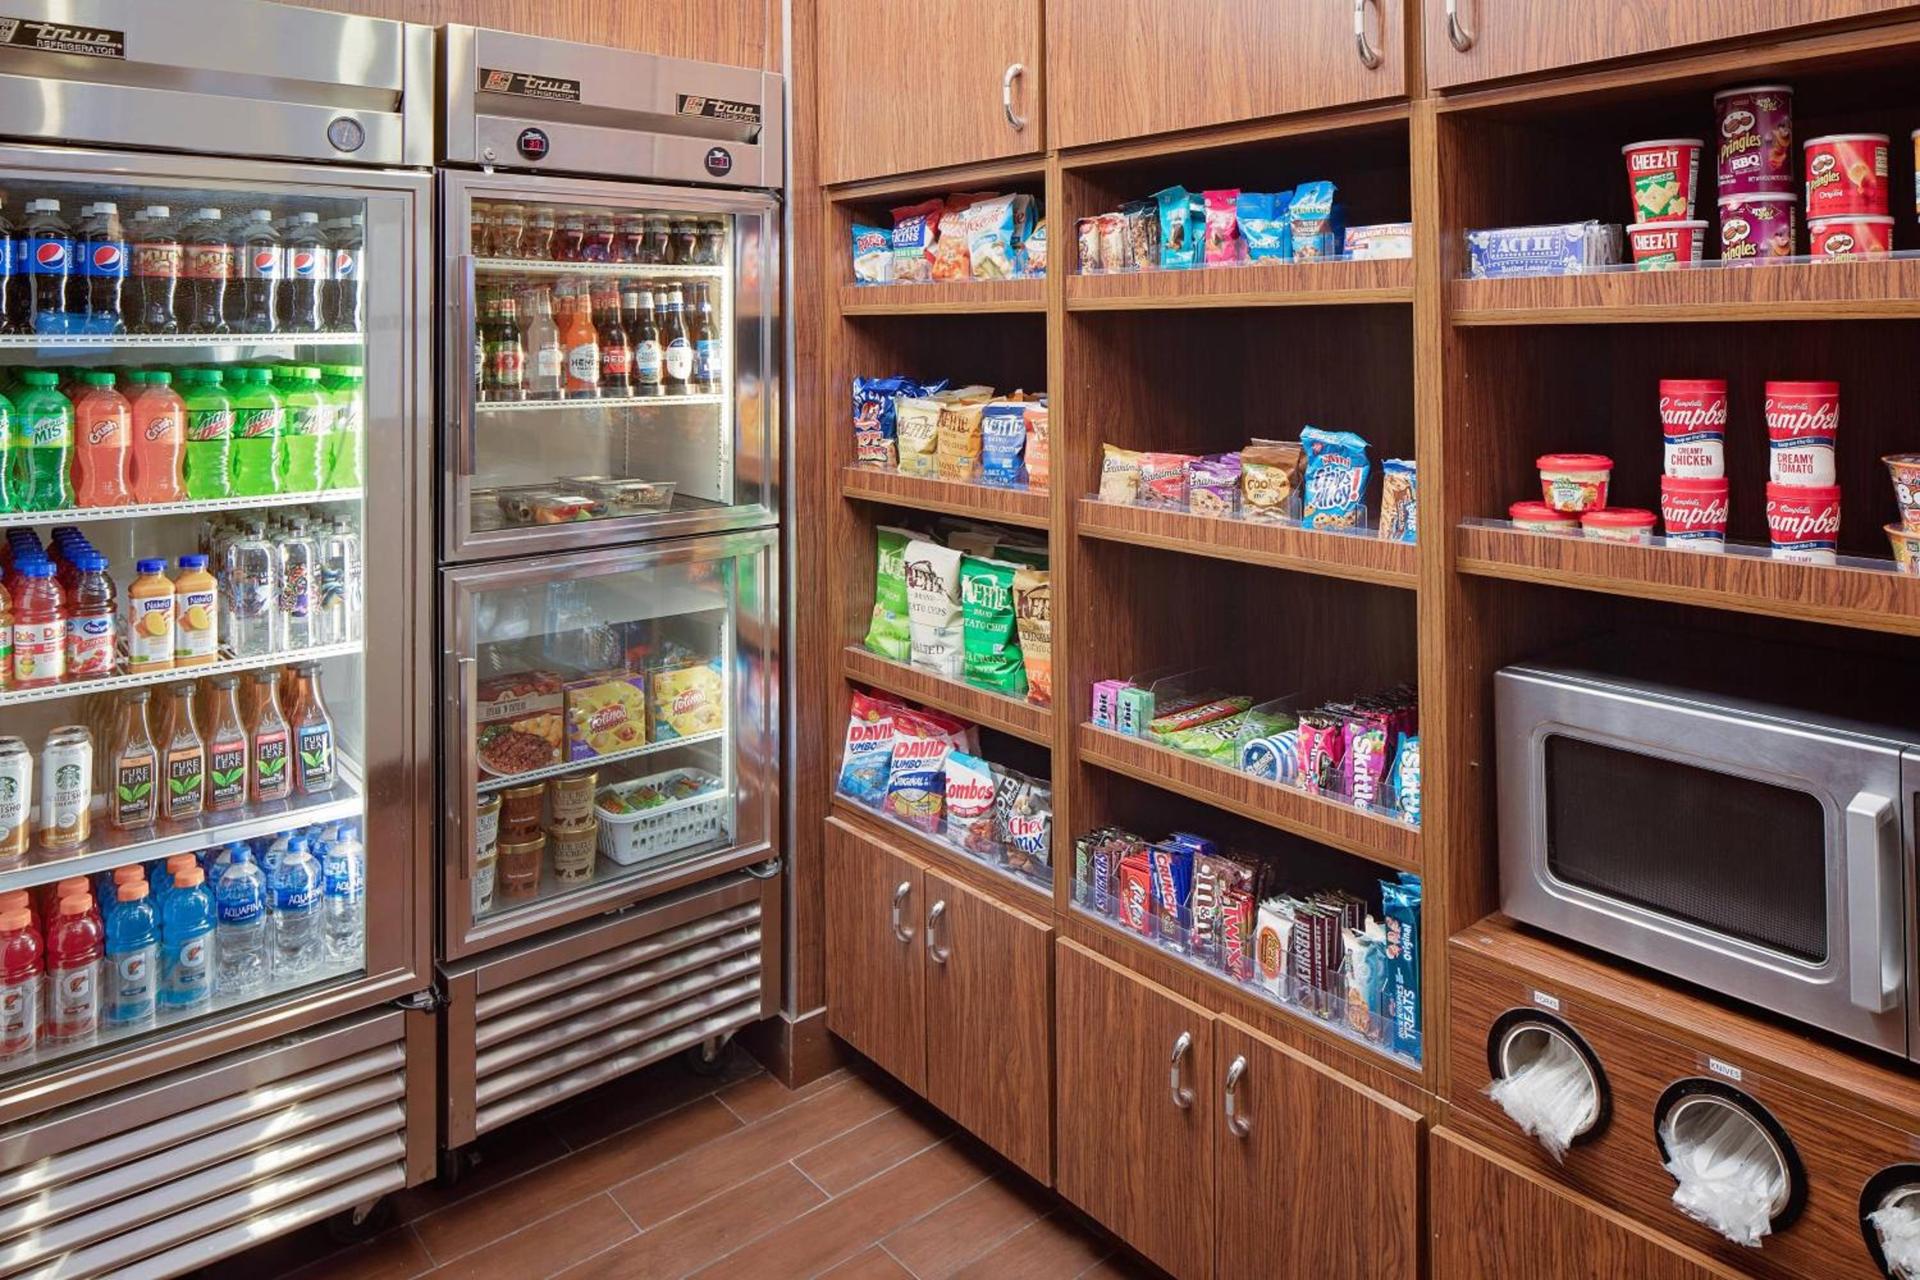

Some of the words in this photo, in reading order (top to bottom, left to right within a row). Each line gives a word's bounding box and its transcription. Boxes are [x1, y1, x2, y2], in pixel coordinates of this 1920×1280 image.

[36, 39, 116, 55] REFRIGERATOR
[1720, 135, 1762, 163] Pringles
[1731, 155, 1760, 170] BBQ
[1810, 171, 1840, 190] Pringles
[1819, 190, 1843, 198] Original
[1499, 238, 1527, 253] ACT
[1535, 236, 1552, 251] II
[34, 427, 64, 445] MIS
[1678, 447, 1703, 455] CREAMY
[1671, 455, 1712, 466] CHICKEN
[1777, 453, 1814, 464] CREAMY
[1778, 463, 1814, 474] TOMATO
[962, 573, 1012, 611] KETTLE
[147, 601, 170, 611] Naked
[261, 742, 283, 752] PURE
[895, 740, 947, 758] DAVID
[215, 751, 242, 762] PURE
[261, 750, 284, 759] LEAF
[173, 758, 199, 769] PURE
[215, 759, 242, 769] LEAF
[122, 767, 149, 777] PURE
[173, 765, 200, 777] LEAF
[122, 774, 149, 785] LEAF
[1156, 853, 1179, 918] CRUNCH
[223, 899, 264, 918] AQUAFINA
[1403, 988, 1416, 1041] TREATS
[1711, 1061, 1741, 1079] KNIVES
